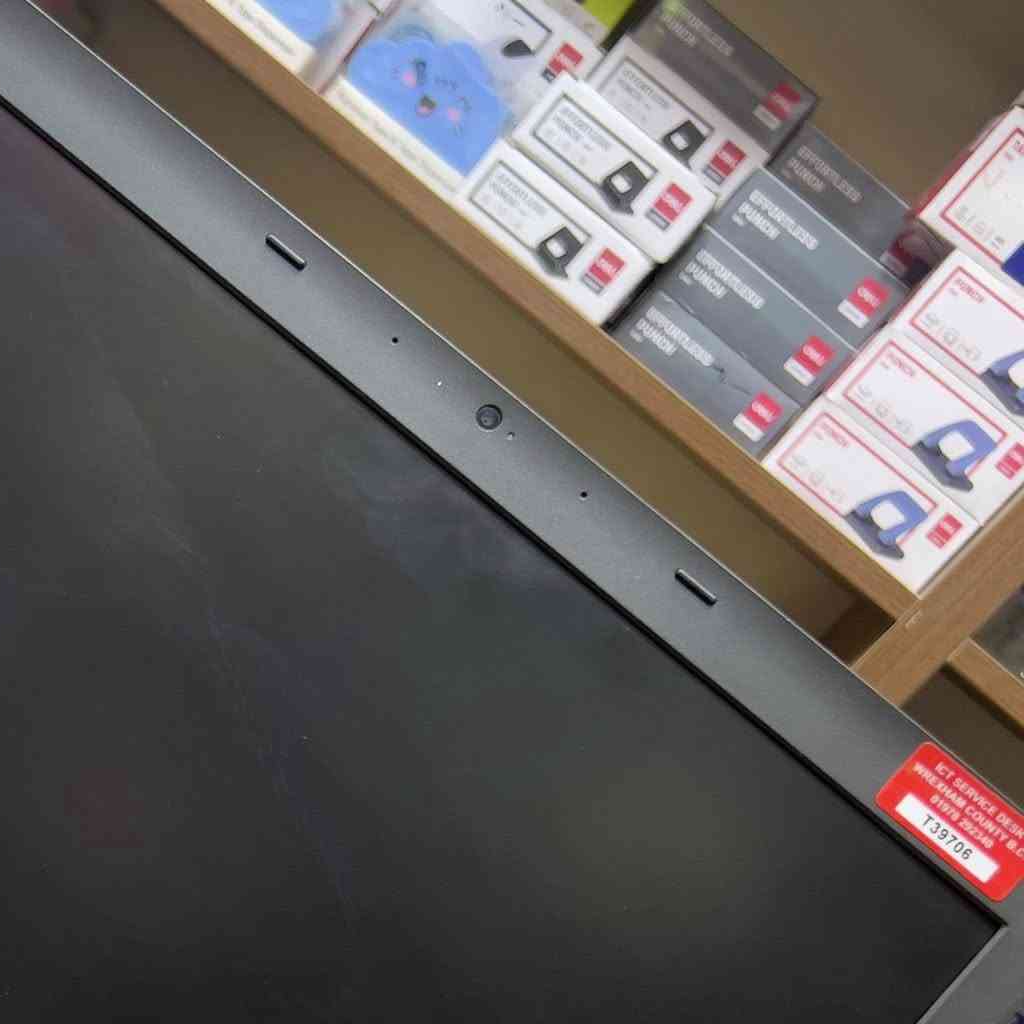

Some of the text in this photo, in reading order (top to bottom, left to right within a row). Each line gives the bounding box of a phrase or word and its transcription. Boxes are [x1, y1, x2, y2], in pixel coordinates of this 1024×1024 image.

[934, 761, 955, 780] ICT
[954, 777, 997, 815] SERVICE
[920, 813, 974, 861] T39706
[964, 803, 1009, 842] COUNTY
